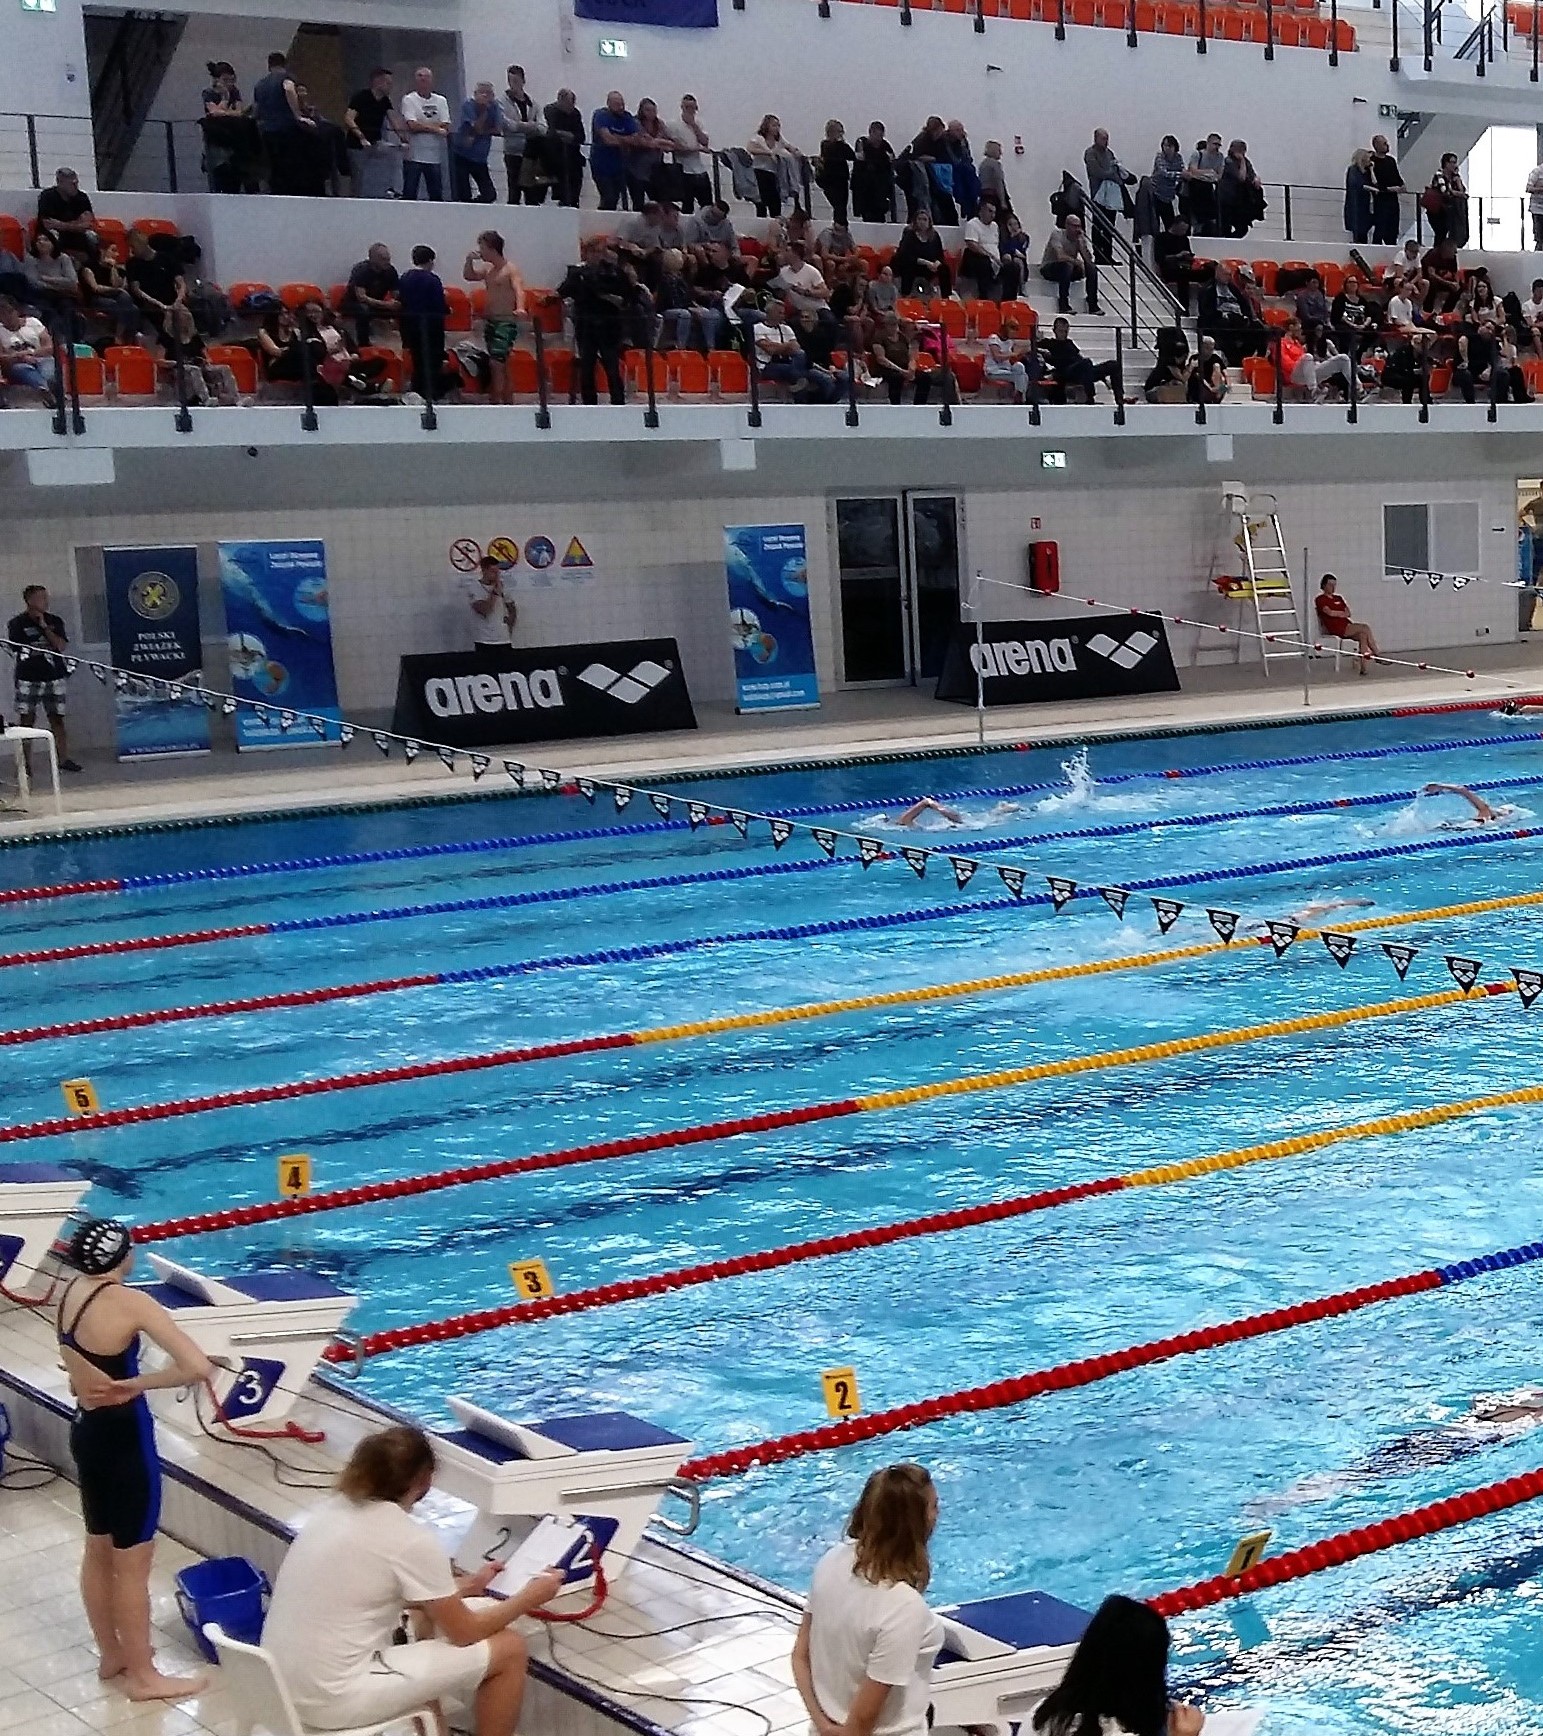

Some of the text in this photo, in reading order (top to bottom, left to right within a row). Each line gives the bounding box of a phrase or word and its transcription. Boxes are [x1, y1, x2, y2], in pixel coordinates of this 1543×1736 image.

[969, 638, 1077, 678] arena
[424, 669, 565, 717] arena
[74, 1088, 90, 1108] 5
[286, 1166, 303, 1189] 4
[522, 1271, 543, 1293] 3
[238, 1370, 264, 1405] 3
[835, 1381, 852, 1410] 2
[482, 1526, 512, 1562] 2
[570, 1528, 595, 1570] 2
[1240, 1546, 1256, 1571] 1
